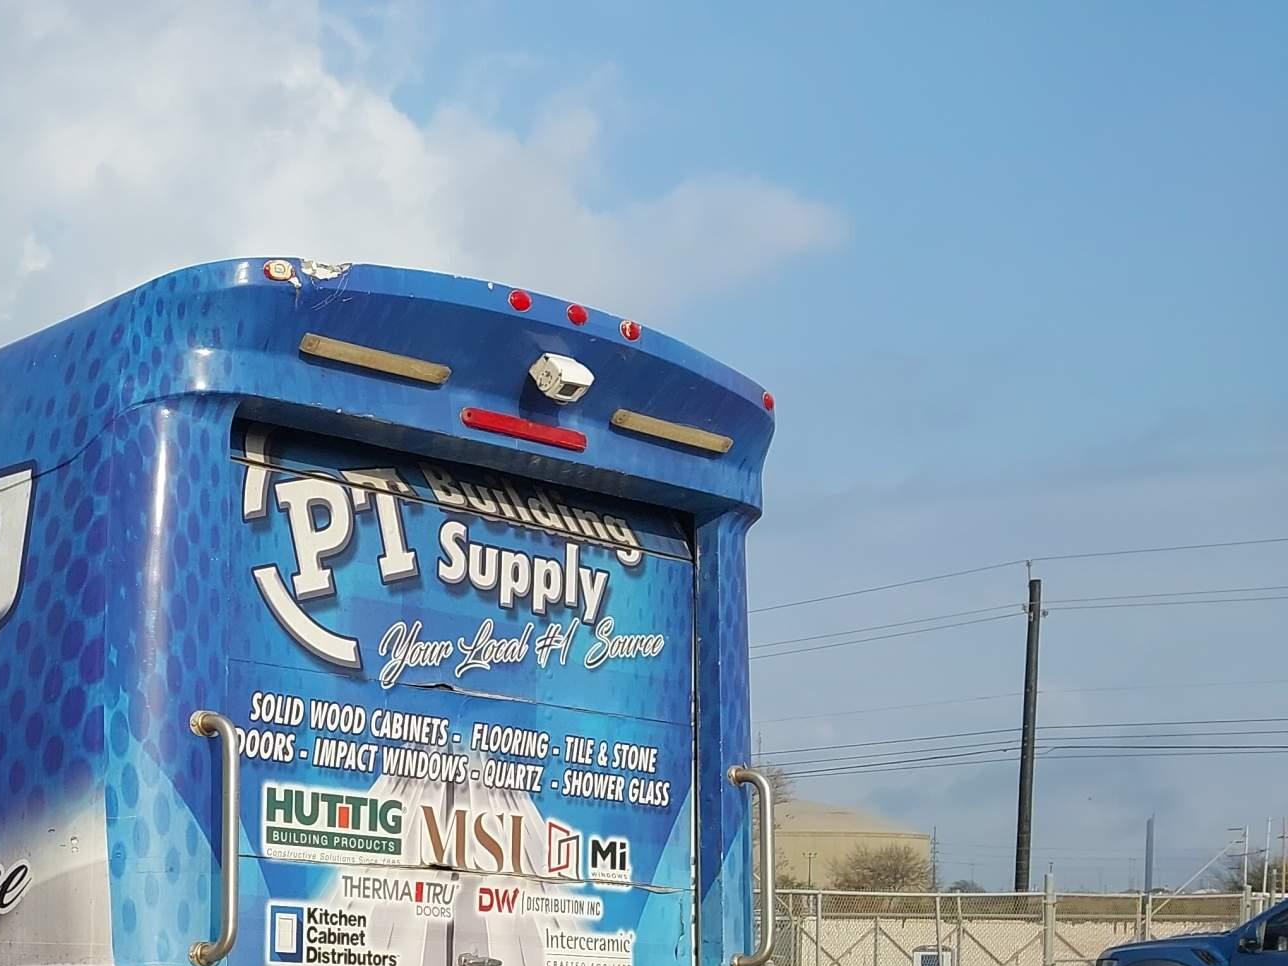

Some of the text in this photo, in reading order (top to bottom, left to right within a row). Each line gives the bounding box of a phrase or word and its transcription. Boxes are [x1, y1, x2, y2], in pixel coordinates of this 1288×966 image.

[419, 462, 643, 566] Building
[275, 467, 420, 601] PT
[437, 521, 610, 624] Supply
[379, 617, 664, 689] Your Local #1 Source
[250, 692, 304, 727] SOLID
[310, 700, 365, 743] WOOD
[371, 710, 449, 746] CABINETS
[472, 721, 549, 758] FLOORING
[565, 736, 593, 765] TILE
[598, 743, 609, 765] &
[612, 744, 658, 774] STONE
[313, 739, 377, 775] IMPACT
[382, 749, 469, 785] WINDOWS
[483, 758, 543, 793] QUARTZ
[563, 769, 627, 803] SHOWER
[629, 778, 671, 808] GLASS
[266, 787, 403, 834] HUTTIG
[272, 830, 396, 852] BUILDING PRODUCTS
[420, 805, 524, 875] MSI
[592, 839, 626, 871] Mi
[342, 875, 455, 905] THERMA TRU
[478, 887, 601, 916] DW DISTRIBUTION INC
[307, 907, 367, 928] Kitchen
[416, 905, 452, 918] DOORS
[307, 926, 366, 946] Cabinet
[545, 927, 631, 953] Interceramic
[306, 947, 397, 966] Distributors
